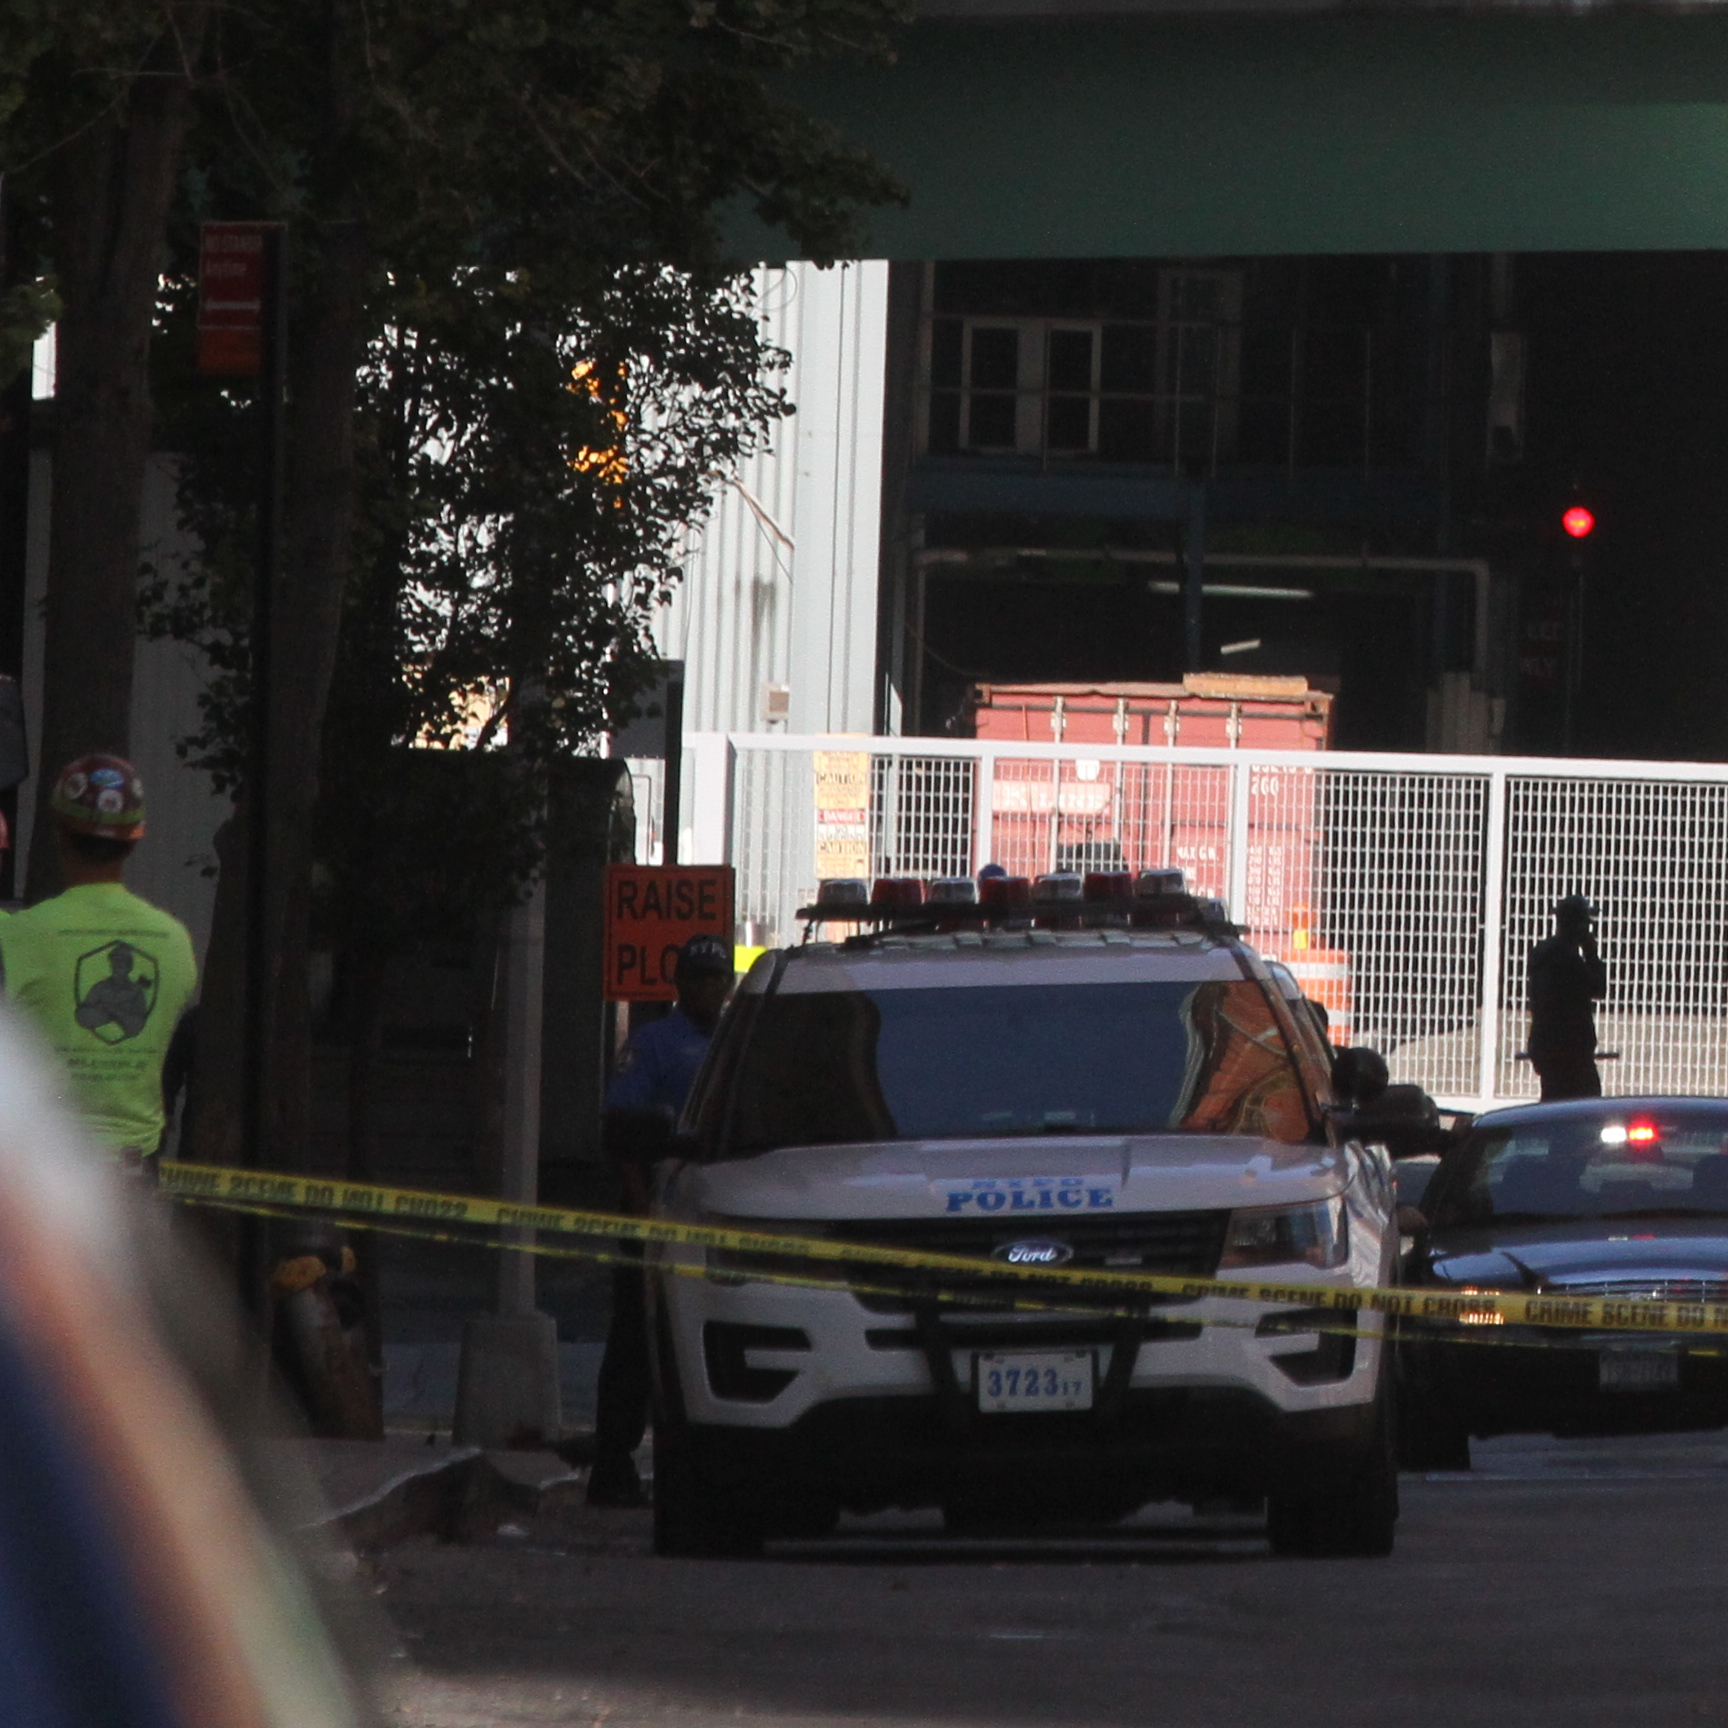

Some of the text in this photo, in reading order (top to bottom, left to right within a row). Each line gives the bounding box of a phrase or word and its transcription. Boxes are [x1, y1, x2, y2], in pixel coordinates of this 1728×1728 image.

[616, 879, 717, 920] RAISE
[616, 943, 680, 985] PLO
[946, 1189, 1114, 1212] POLICE
[1008, 1245, 1058, 1262] Ford
[1370, 1293, 1414, 1314] NOT
[1525, 1299, 1593, 1325] CRIME
[1603, 1302, 1667, 1327] SCENE
[988, 1368, 1059, 1397] 3723
